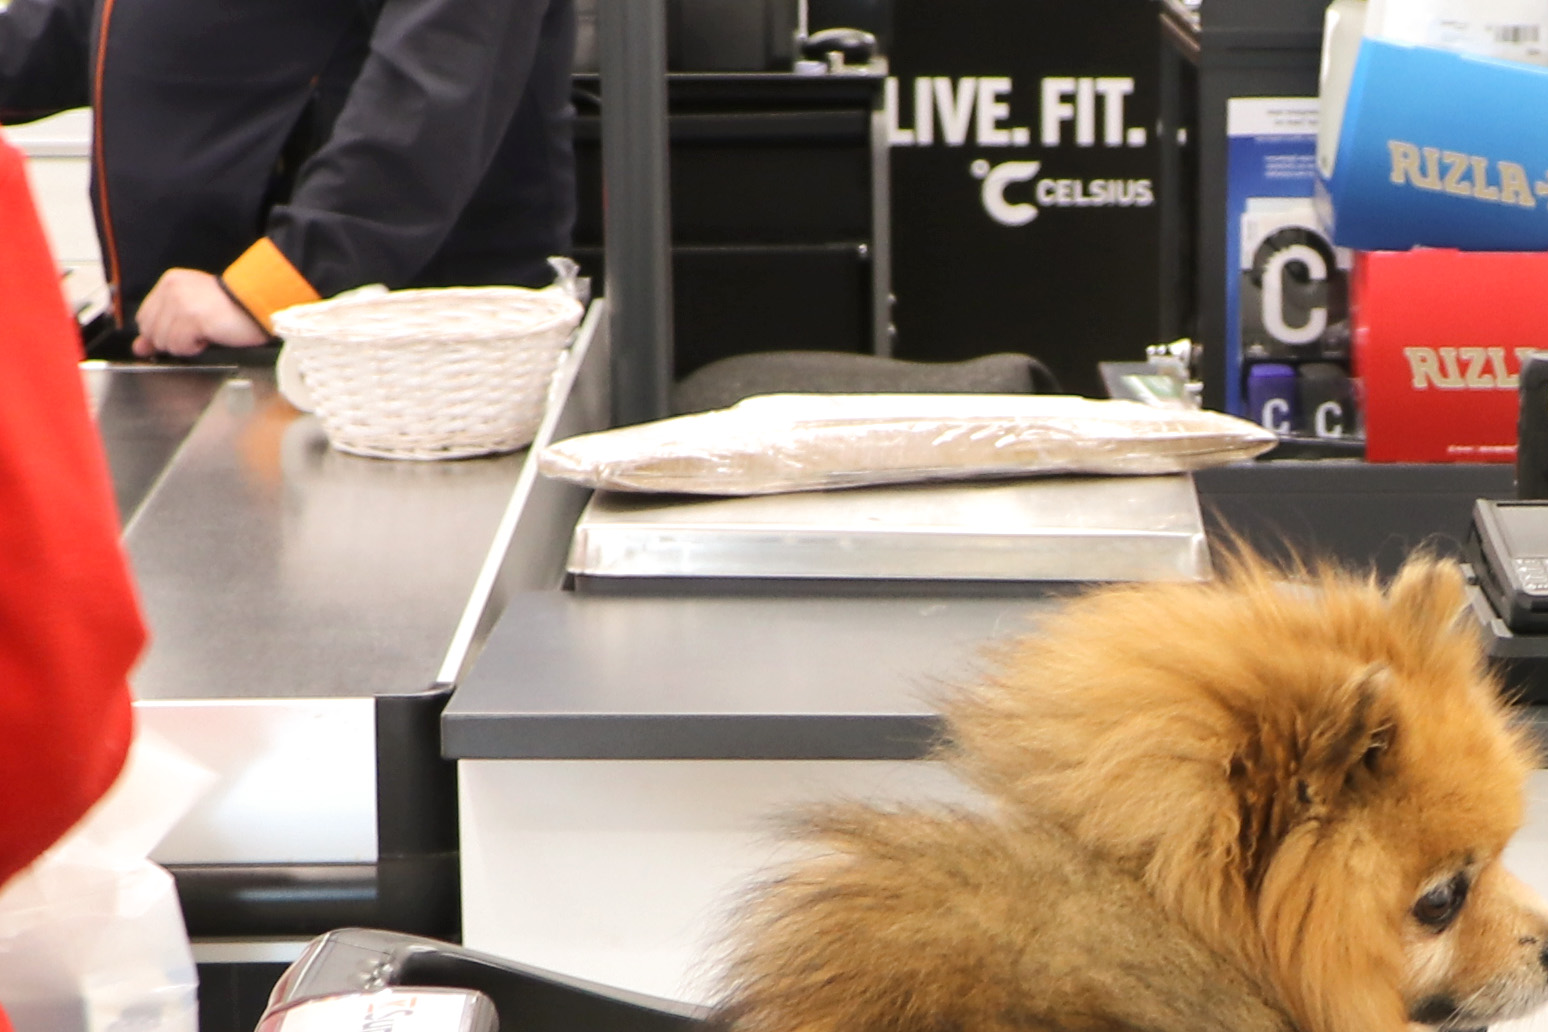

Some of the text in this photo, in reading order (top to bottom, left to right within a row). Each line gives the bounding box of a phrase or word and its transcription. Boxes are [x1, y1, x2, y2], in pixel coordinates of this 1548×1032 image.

[884, 76, 1147, 147] LIVE. FIT.
[1036, 178, 1154, 207] CELSIUS
